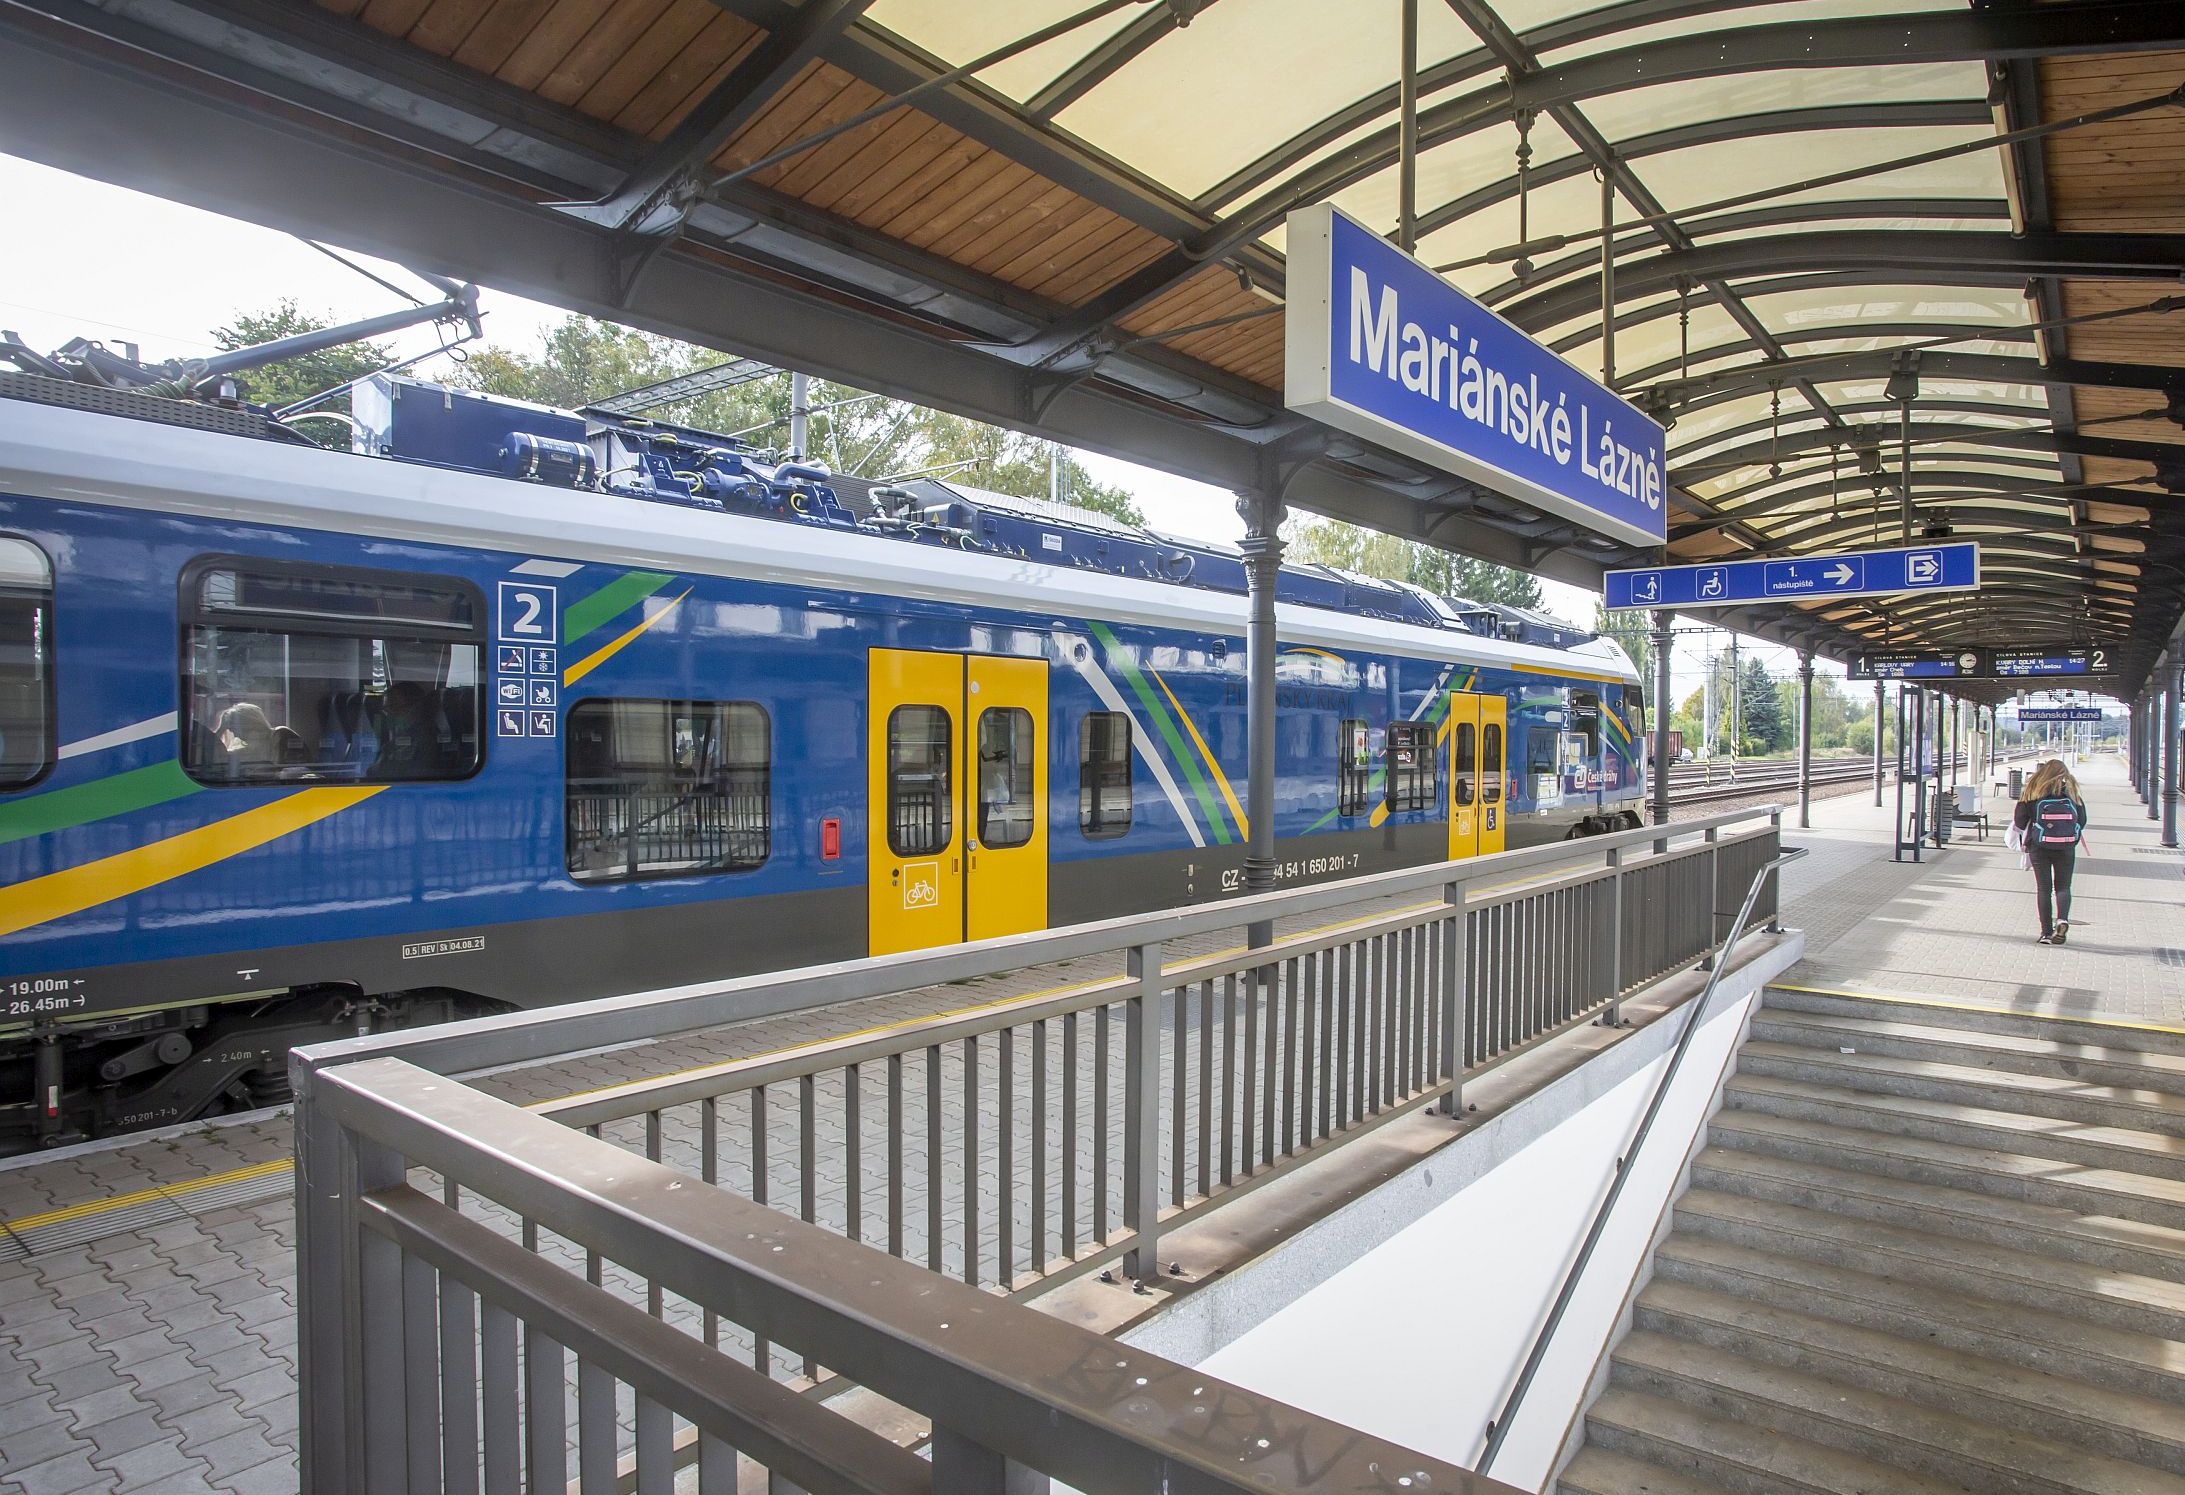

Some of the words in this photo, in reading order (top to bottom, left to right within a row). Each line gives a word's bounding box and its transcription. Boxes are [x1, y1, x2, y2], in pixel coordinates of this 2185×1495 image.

[1350, 265, 1572, 465] Mariánské
[1580, 404, 1660, 510] Lázně
[1788, 566, 1798, 577] 1.
[1772, 580, 1814, 589] nástupiště
[513, 593, 541, 633] 2
[1857, 656, 1870, 672] 1.
[2092, 650, 2108, 667] 2.
[1563, 713, 1569, 728] 2
[2020, 710, 2068, 719] Mariánské
[2070, 710, 2100, 719] Lázně
[1221, 869, 1239, 889] CZ
[1285, 862, 1299, 878] 54
[1301, 860, 1306, 875] 1
[1309, 857, 1327, 874] 650
[1328, 855, 1345, 872] 201
[404, 946, 418, 956] 0.5
[421, 944, 436, 954] REV
[450, 939, 484, 951] 04.08.21
[9, 979, 69, 996] 19.00m
[9, 997, 70, 1015] 26.45m
[220, 1051, 252, 1063] 2.40m
